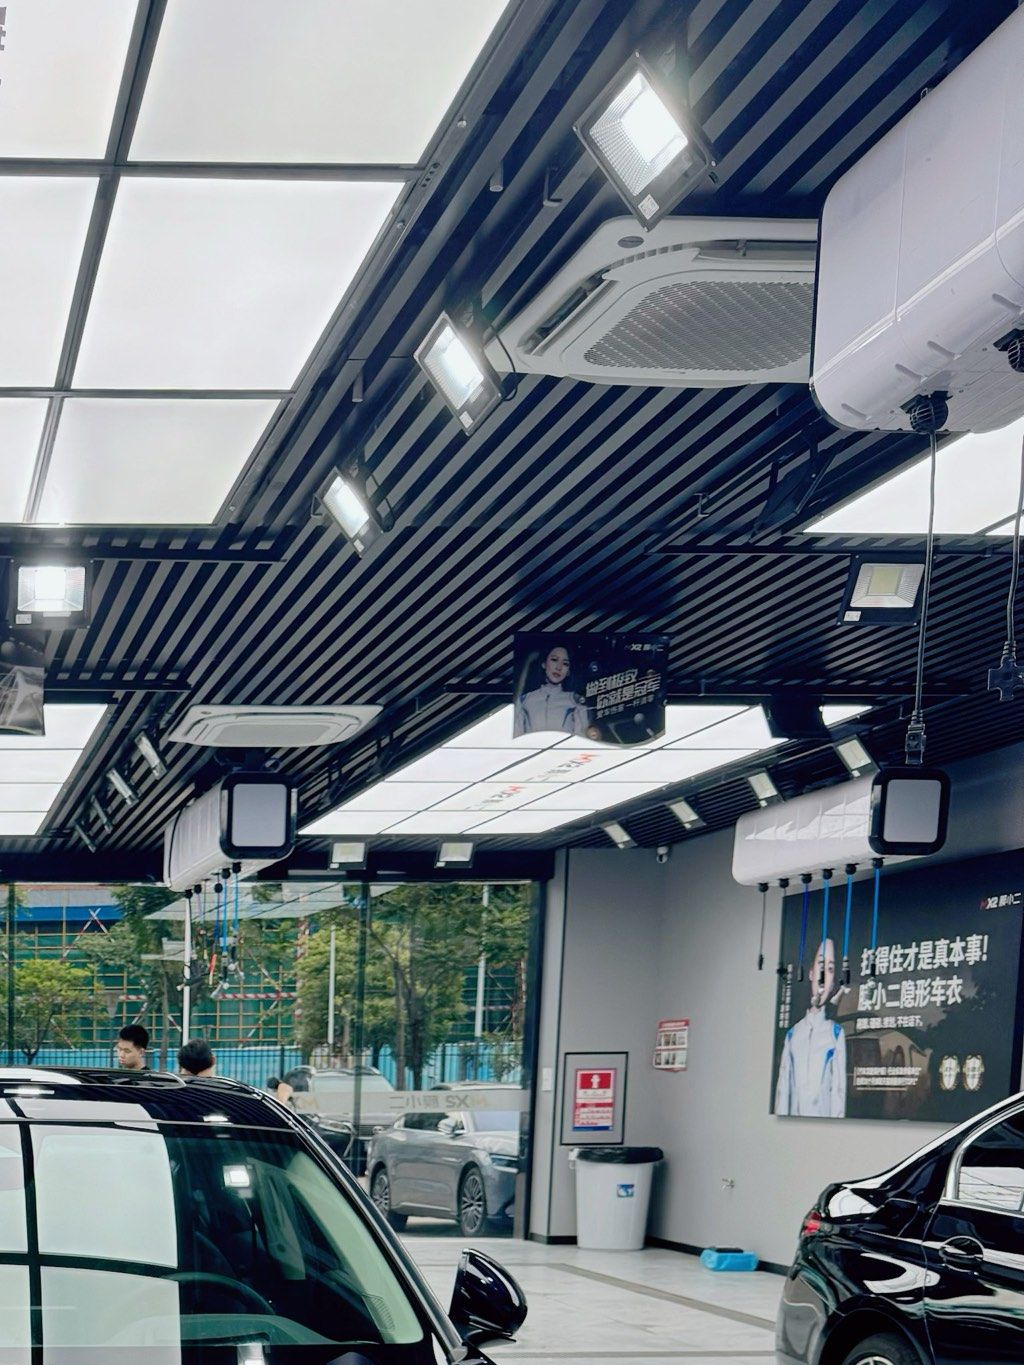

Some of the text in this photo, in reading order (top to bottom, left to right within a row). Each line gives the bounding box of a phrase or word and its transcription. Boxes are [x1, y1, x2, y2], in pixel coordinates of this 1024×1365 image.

[586, 668, 639, 697] 做到极致
[596, 673, 662, 710] 你就是冠军
